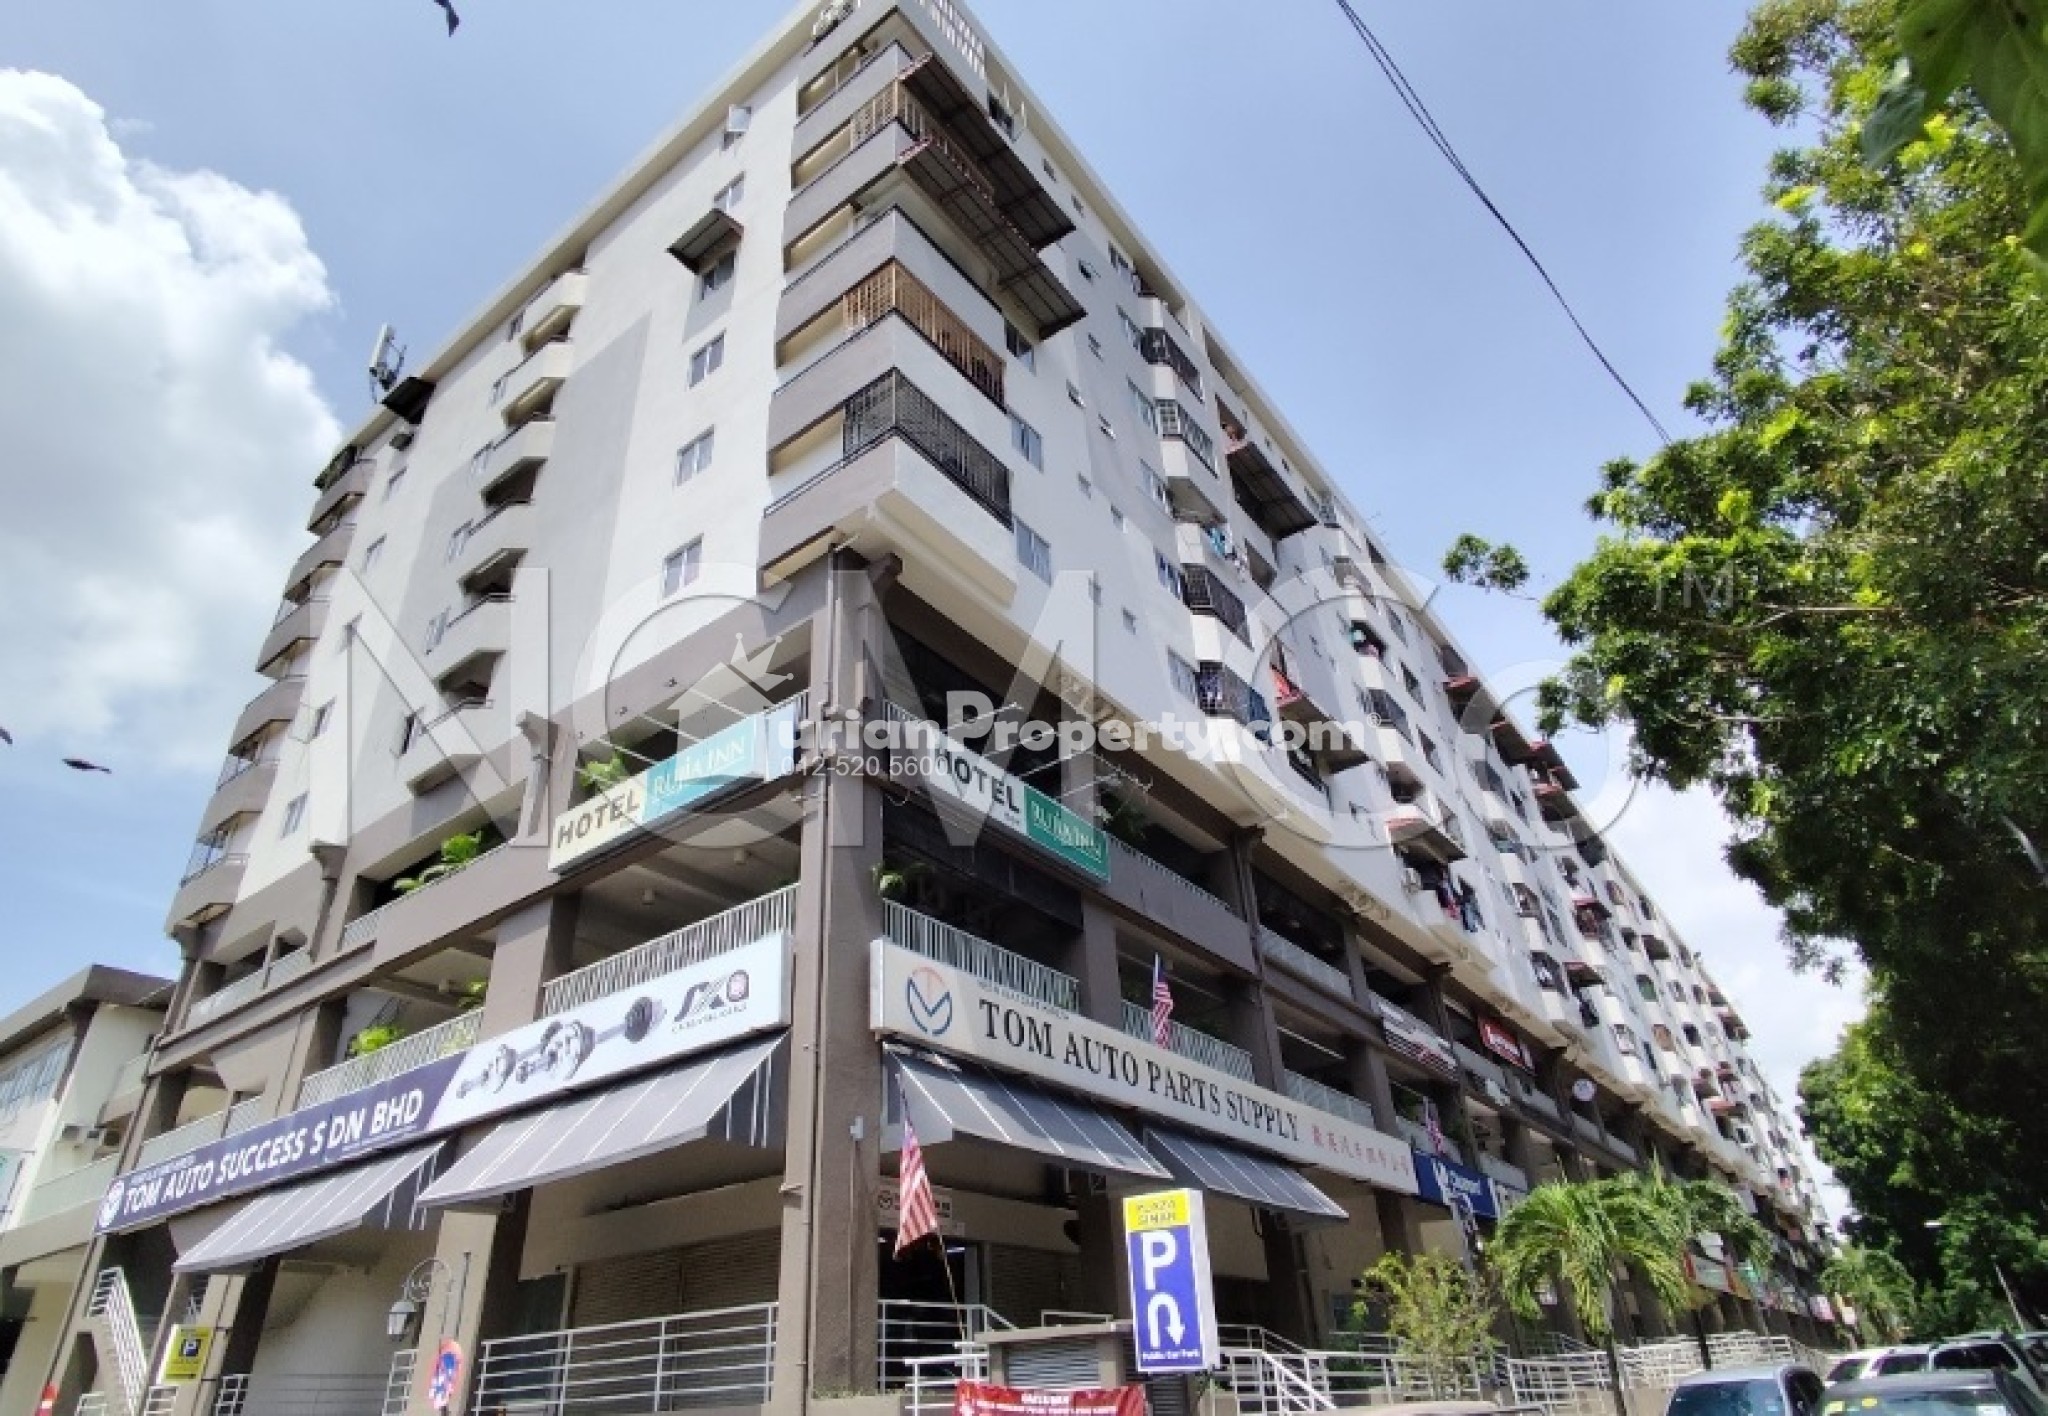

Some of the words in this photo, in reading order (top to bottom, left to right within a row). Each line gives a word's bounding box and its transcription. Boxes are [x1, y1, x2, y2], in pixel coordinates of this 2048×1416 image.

[557, 787, 641, 849] HOTEL
[708, 735, 746, 772] INN
[934, 746, 1020, 814] HOTEL
[978, 998, 1054, 1059] TOM
[1063, 1031, 1139, 1087] AUTO
[1145, 1058, 1221, 1117] PARTS
[1226, 1090, 1300, 1142] SUPPLY
[123, 1181, 163, 1214] TOM
[161, 1158, 214, 1203] AUTO
[216, 1127, 307, 1184] SUCCESS
[371, 1088, 424, 1132] BHD
[1141, 1230, 1176, 1290] P
